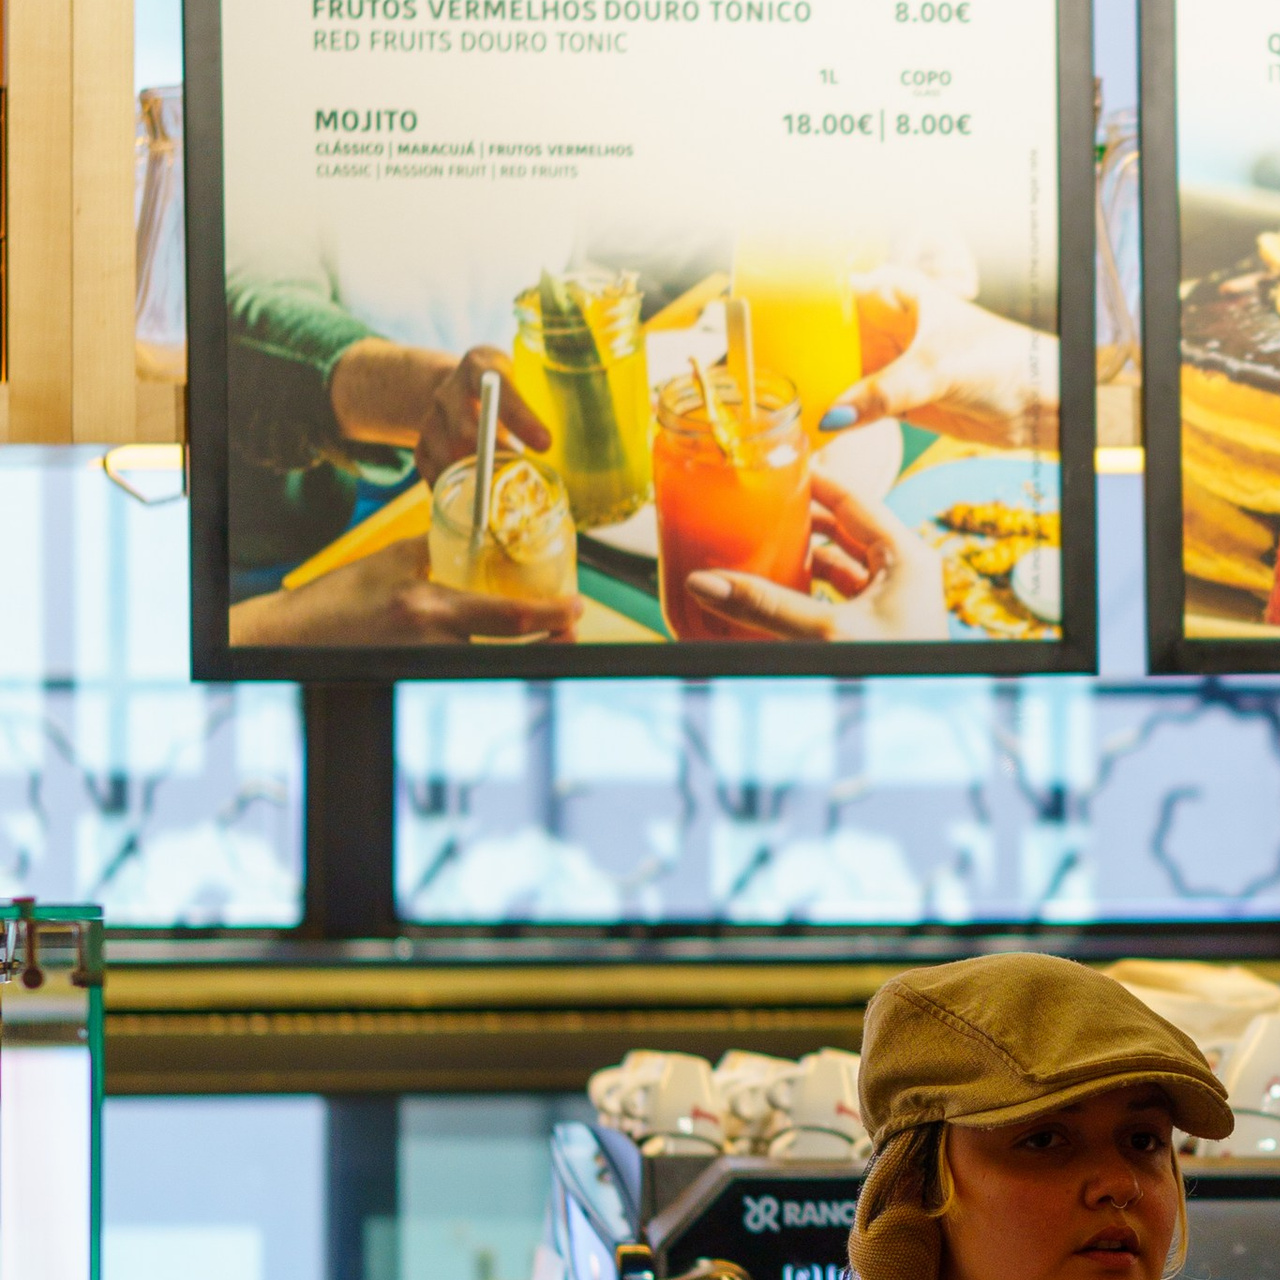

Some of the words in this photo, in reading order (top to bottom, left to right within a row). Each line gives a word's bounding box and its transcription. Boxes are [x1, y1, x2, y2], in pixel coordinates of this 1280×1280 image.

[604, 0, 700, 22] DOURO
[895, 2, 971, 23] 8.00€
[314, 30, 360, 51] RED
[370, 30, 452, 52] FRUITS
[460, 31, 547, 53] DOURO
[556, 32, 627, 53] TONIC
[819, 69, 838, 85] 1L
[900, 70, 952, 86] COPO
[315, 110, 417, 132] MOJITO
[783, 114, 873, 135] 18.00€
[896, 114, 971, 135] 8.00€
[315, 140, 384, 156] CLÁSSICO
[397, 141, 474, 156] MARACUJÁ
[489, 144, 542, 156] FRUTOS
[547, 144, 633, 157] VERMELHOS
[316, 164, 370, 177] CLASSIC
[385, 164, 444, 177] PASSION
[448, 164, 486, 178] FRUIT
[500, 165, 527, 178] RED
[531, 165, 578, 179] FRUITS
